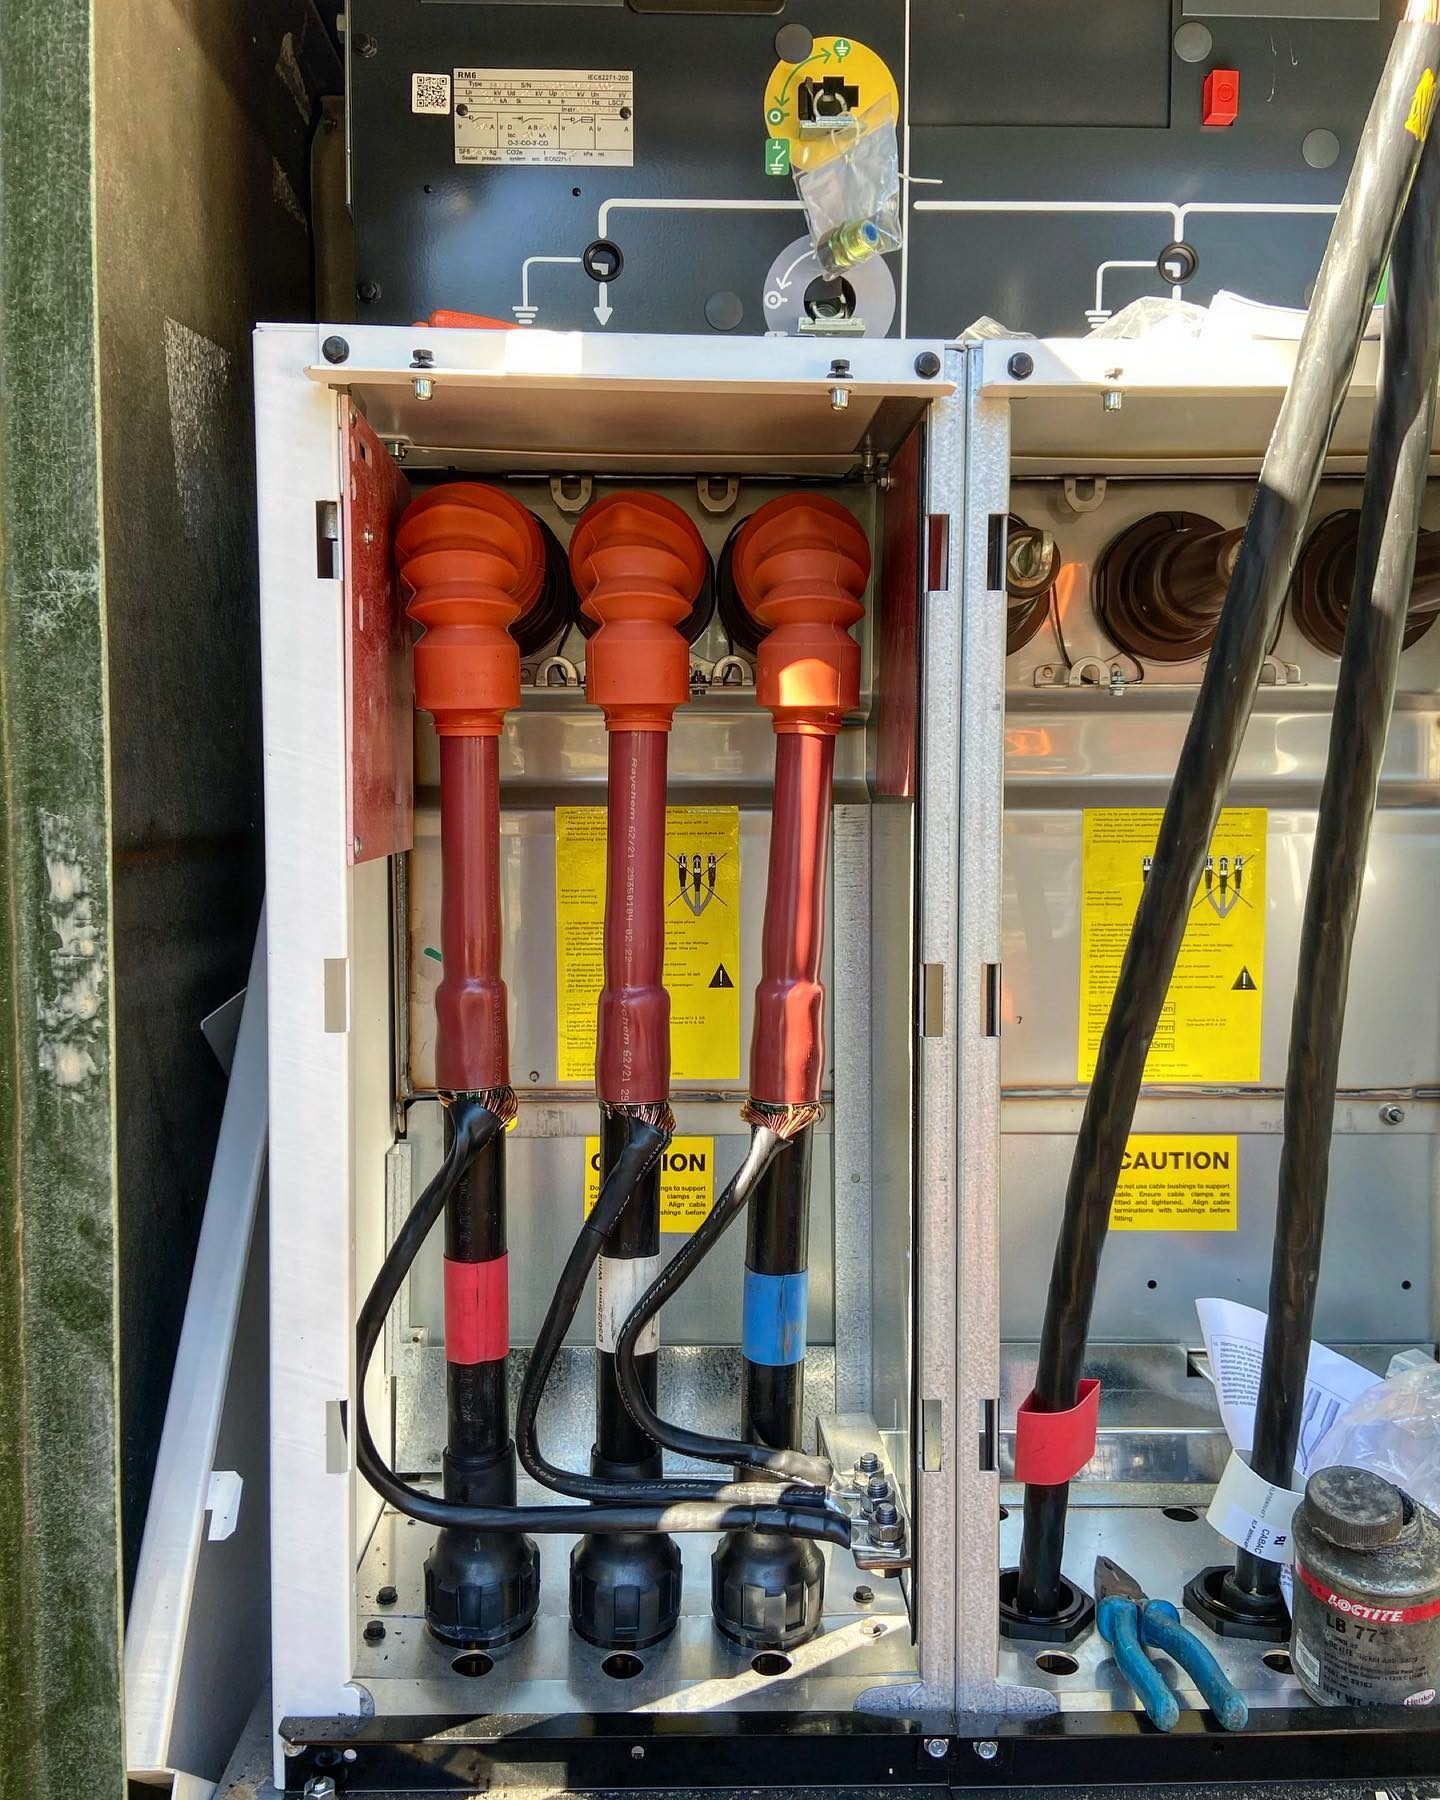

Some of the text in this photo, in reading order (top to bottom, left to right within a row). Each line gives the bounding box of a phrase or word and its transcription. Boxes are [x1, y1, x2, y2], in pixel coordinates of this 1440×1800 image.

[629, 757, 638, 820] Raychem
[1120, 1151, 1230, 1170] CAUTION
[681, 1185, 706, 1193] support
[1254, 1528, 1270, 1555] CABAC
[1328, 1594, 1404, 1622] LOCTITE
[1326, 1612, 1346, 1634] LB
[1405, 1690, 1435, 1707] Henkel
